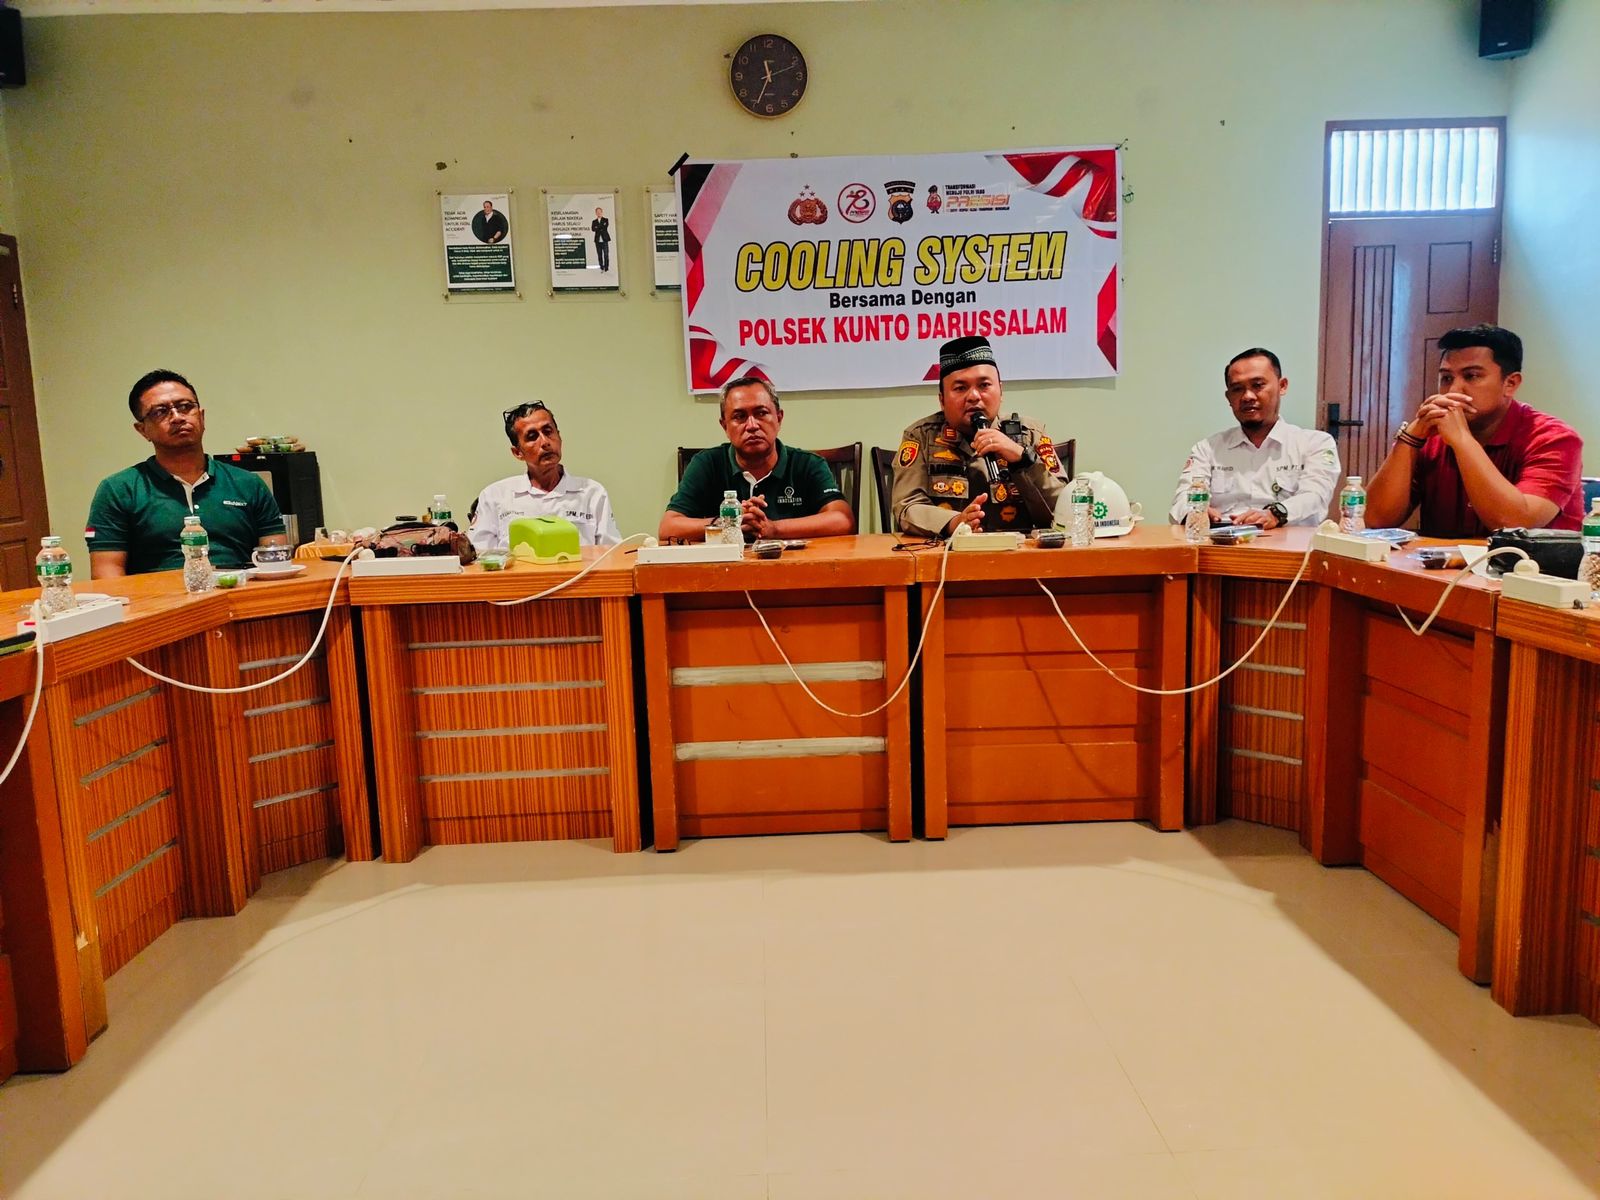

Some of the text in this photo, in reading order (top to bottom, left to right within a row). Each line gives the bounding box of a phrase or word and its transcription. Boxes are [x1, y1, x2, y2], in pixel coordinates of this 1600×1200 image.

[763, 39, 774, 49] 12
[738, 56, 749, 65] 10
[791, 56, 799, 65] 2
[735, 72, 743, 81] 9
[796, 72, 803, 81] 3
[739, 88, 748, 97] 8
[765, 103, 774, 113] 6
[780, 99, 788, 108] 5
[735, 231, 1068, 293] COOLING SYSTEM
[829, 289, 977, 309] Bersama Dengan
[739, 307, 1067, 346] POLSEK KUNTO DARUSSALAM
